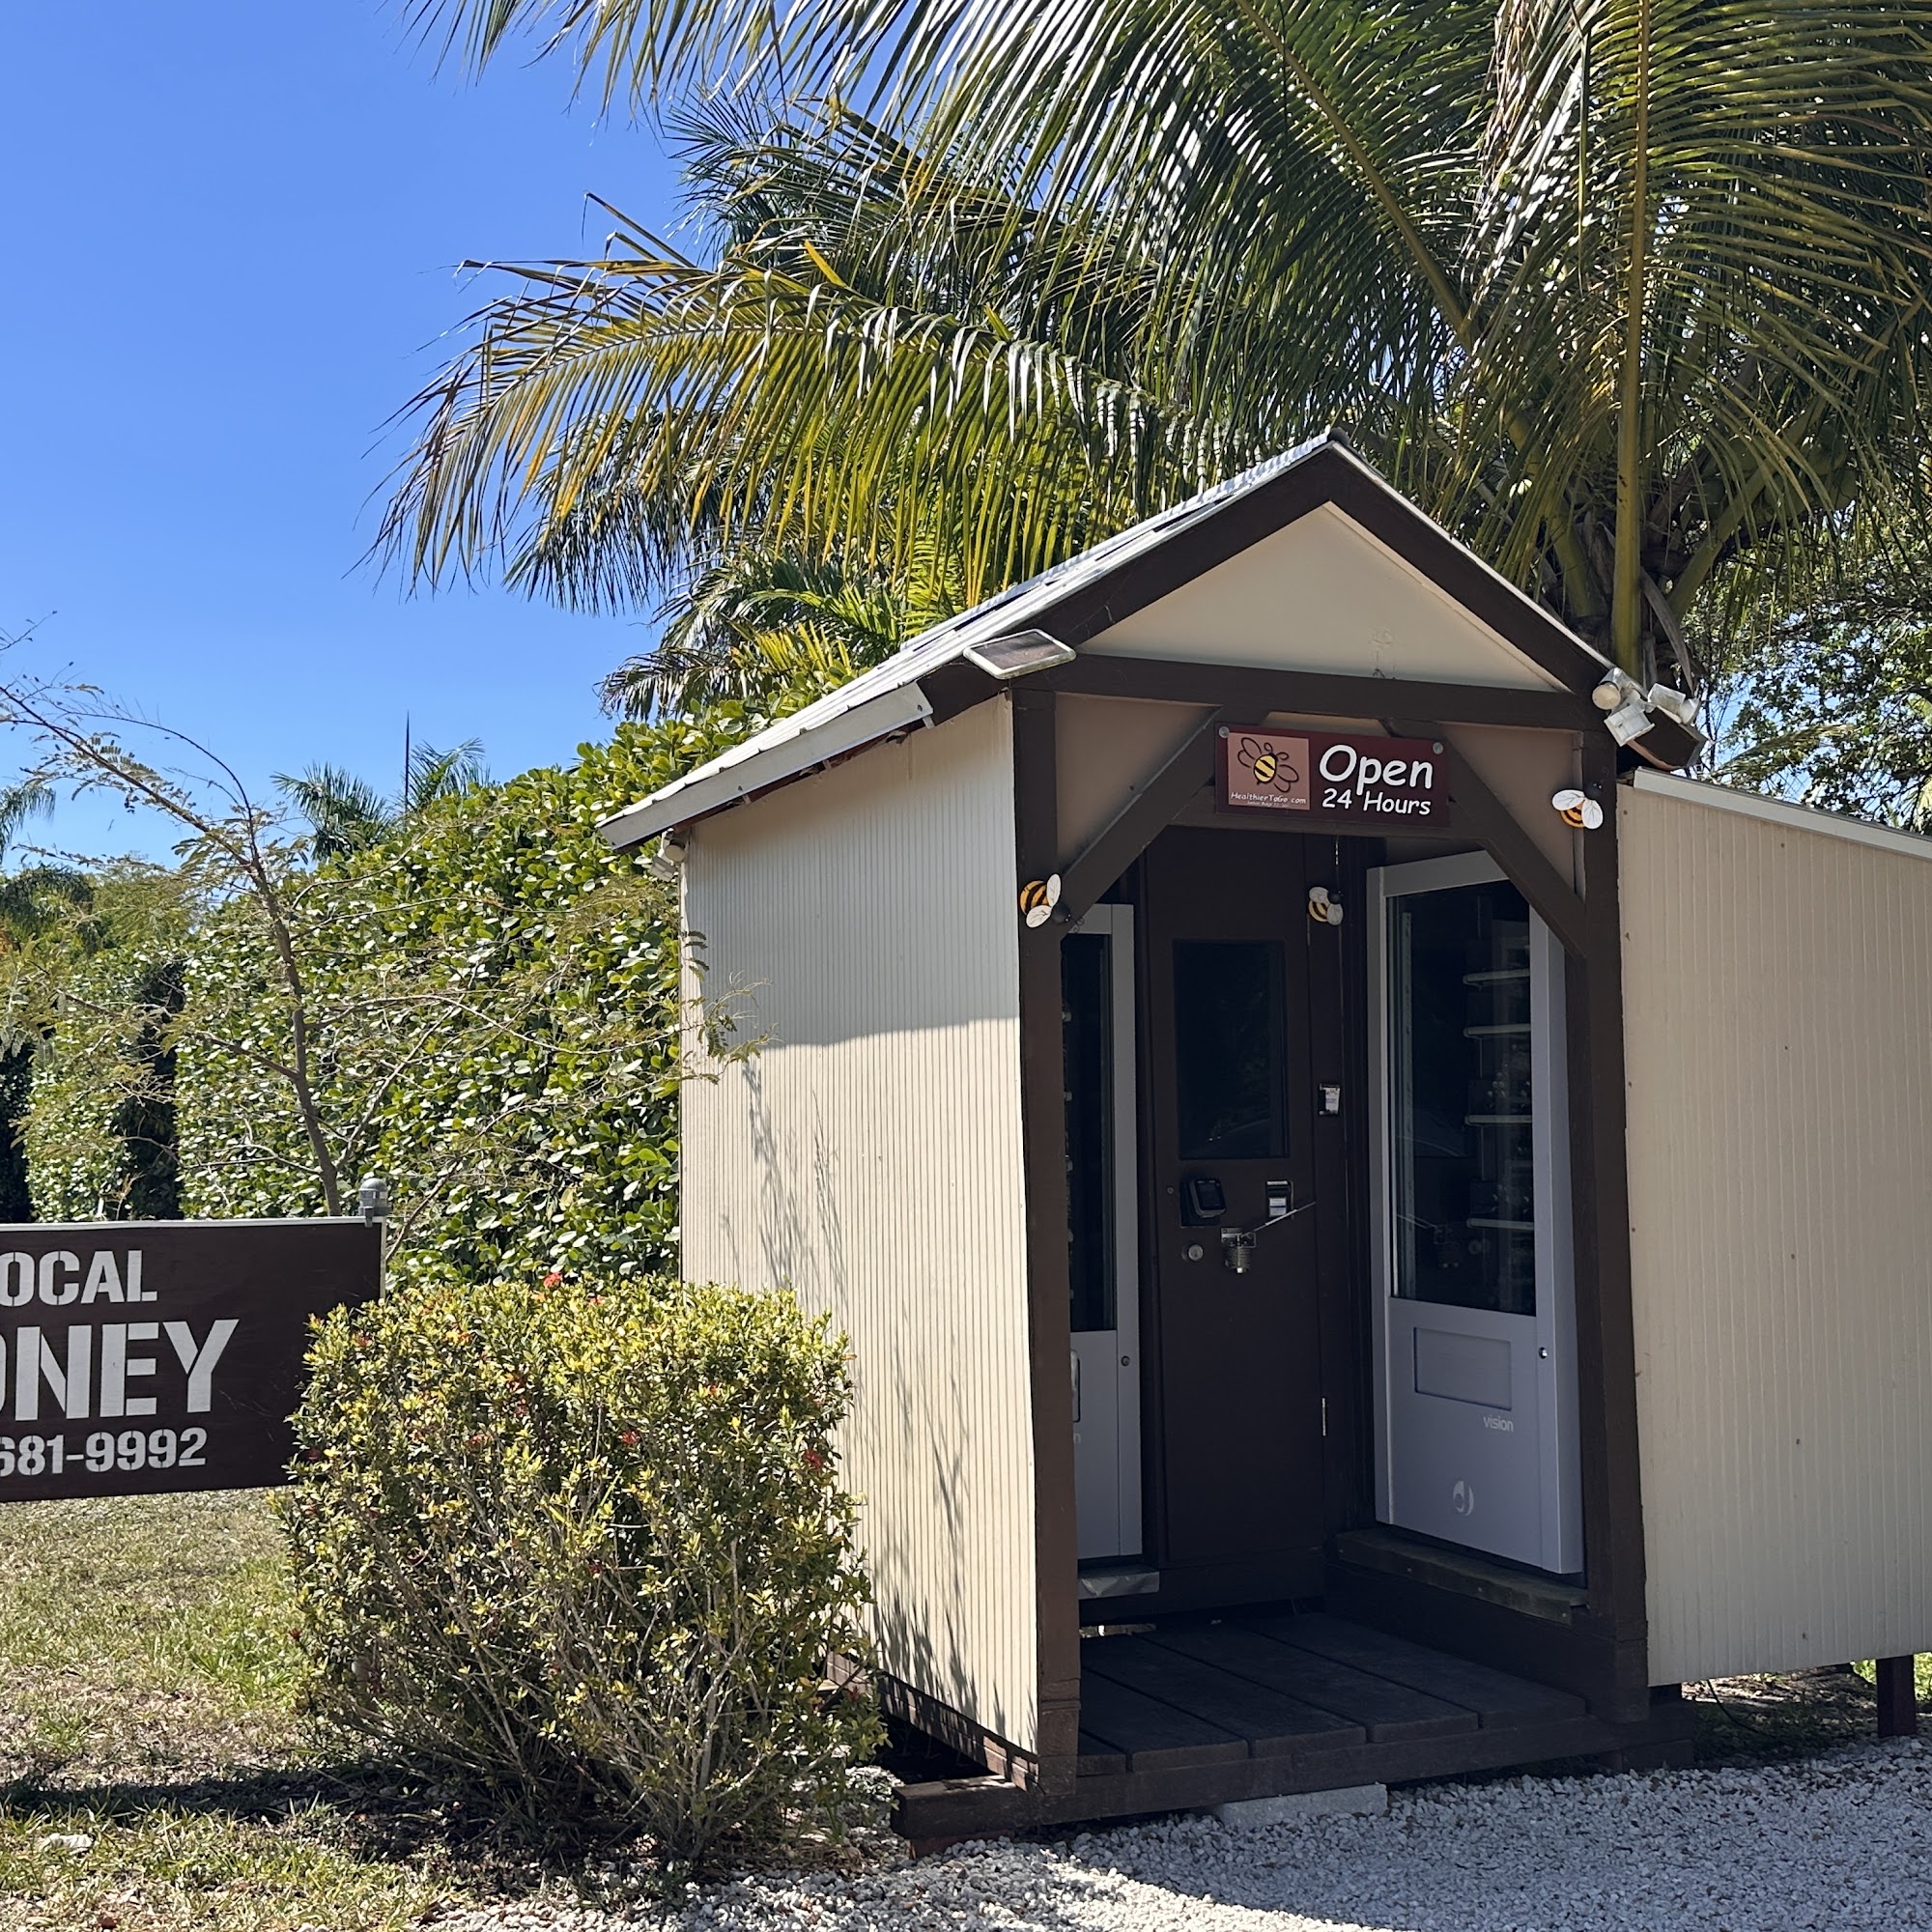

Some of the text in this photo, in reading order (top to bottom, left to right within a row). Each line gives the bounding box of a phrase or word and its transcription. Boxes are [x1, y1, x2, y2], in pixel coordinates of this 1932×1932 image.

[1320, 744, 1433, 795] Open
[1231, 792, 1306, 804] HealthierToGocom
[1322, 788, 1432, 815] 24 Hours
[0, 1319, 240, 1421] NEY
[1483, 1416, 1514, 1432] vision
